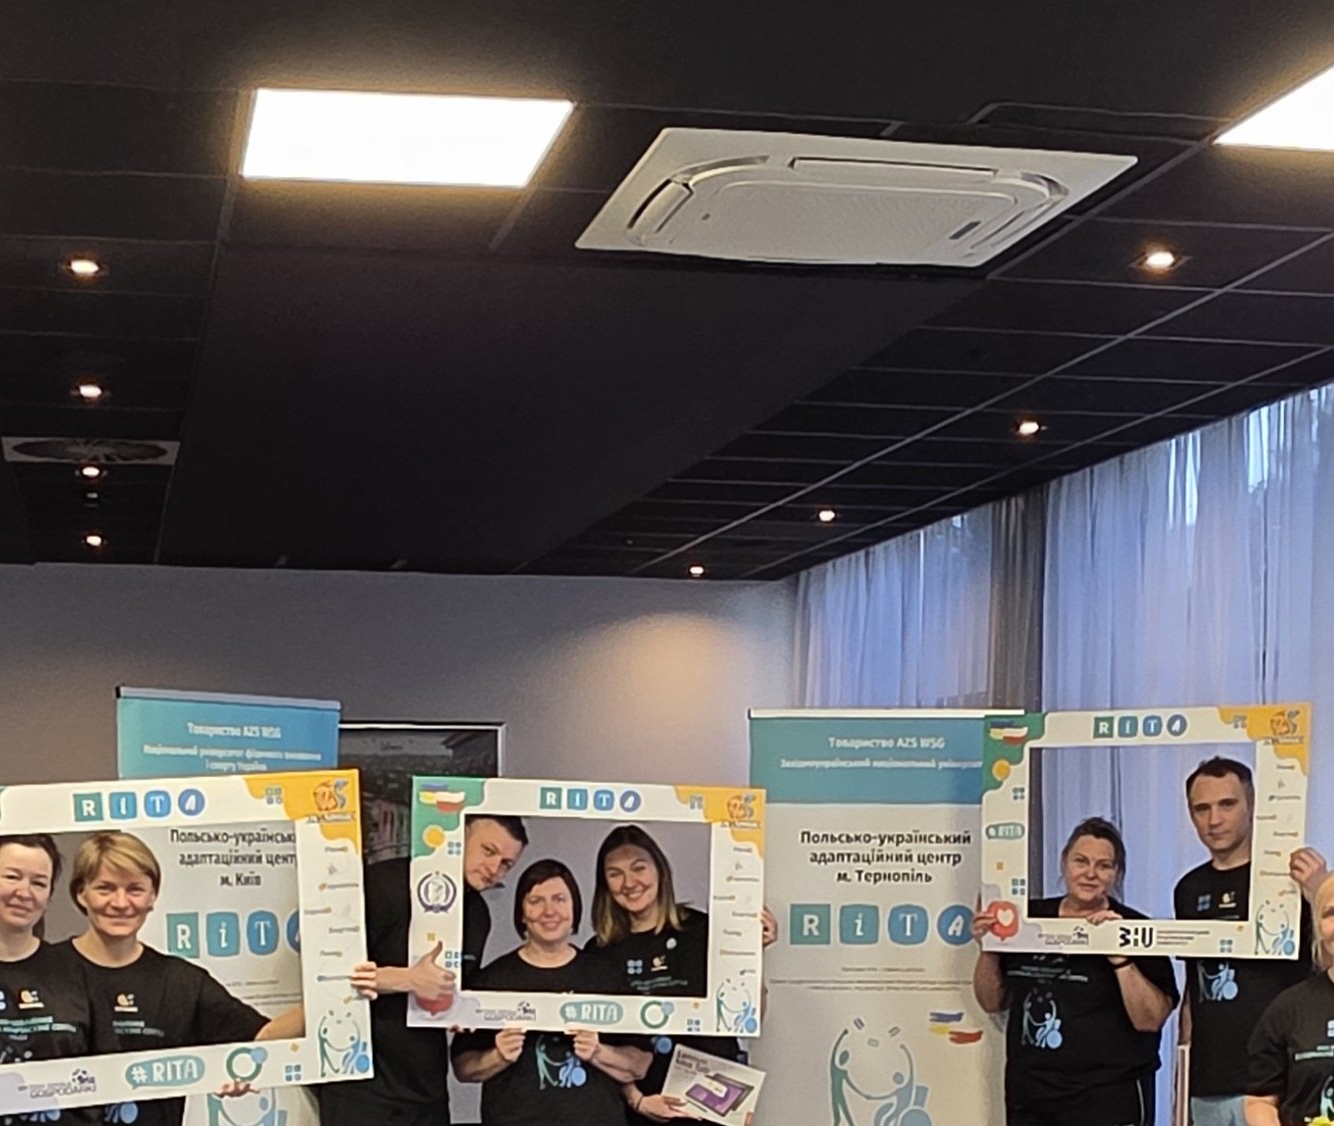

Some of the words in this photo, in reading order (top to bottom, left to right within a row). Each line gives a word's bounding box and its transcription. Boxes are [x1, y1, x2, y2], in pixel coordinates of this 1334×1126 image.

[828, 737, 895, 750] Товариство
[896, 737, 918, 749] AZS
[919, 737, 945, 749] WSG
[800, 829, 972, 853] Польсько-український
[179, 849, 263, 866] адаптаційний
[265, 855, 297, 867] цент
[809, 849, 914, 866] адаптаційний
[917, 852, 962, 867] центр
[235, 871, 261, 886] Київ
[836, 872, 852, 883] м.
[855, 869, 933, 885] Тернопіль
[131, 1058, 198, 1084] #RITA
